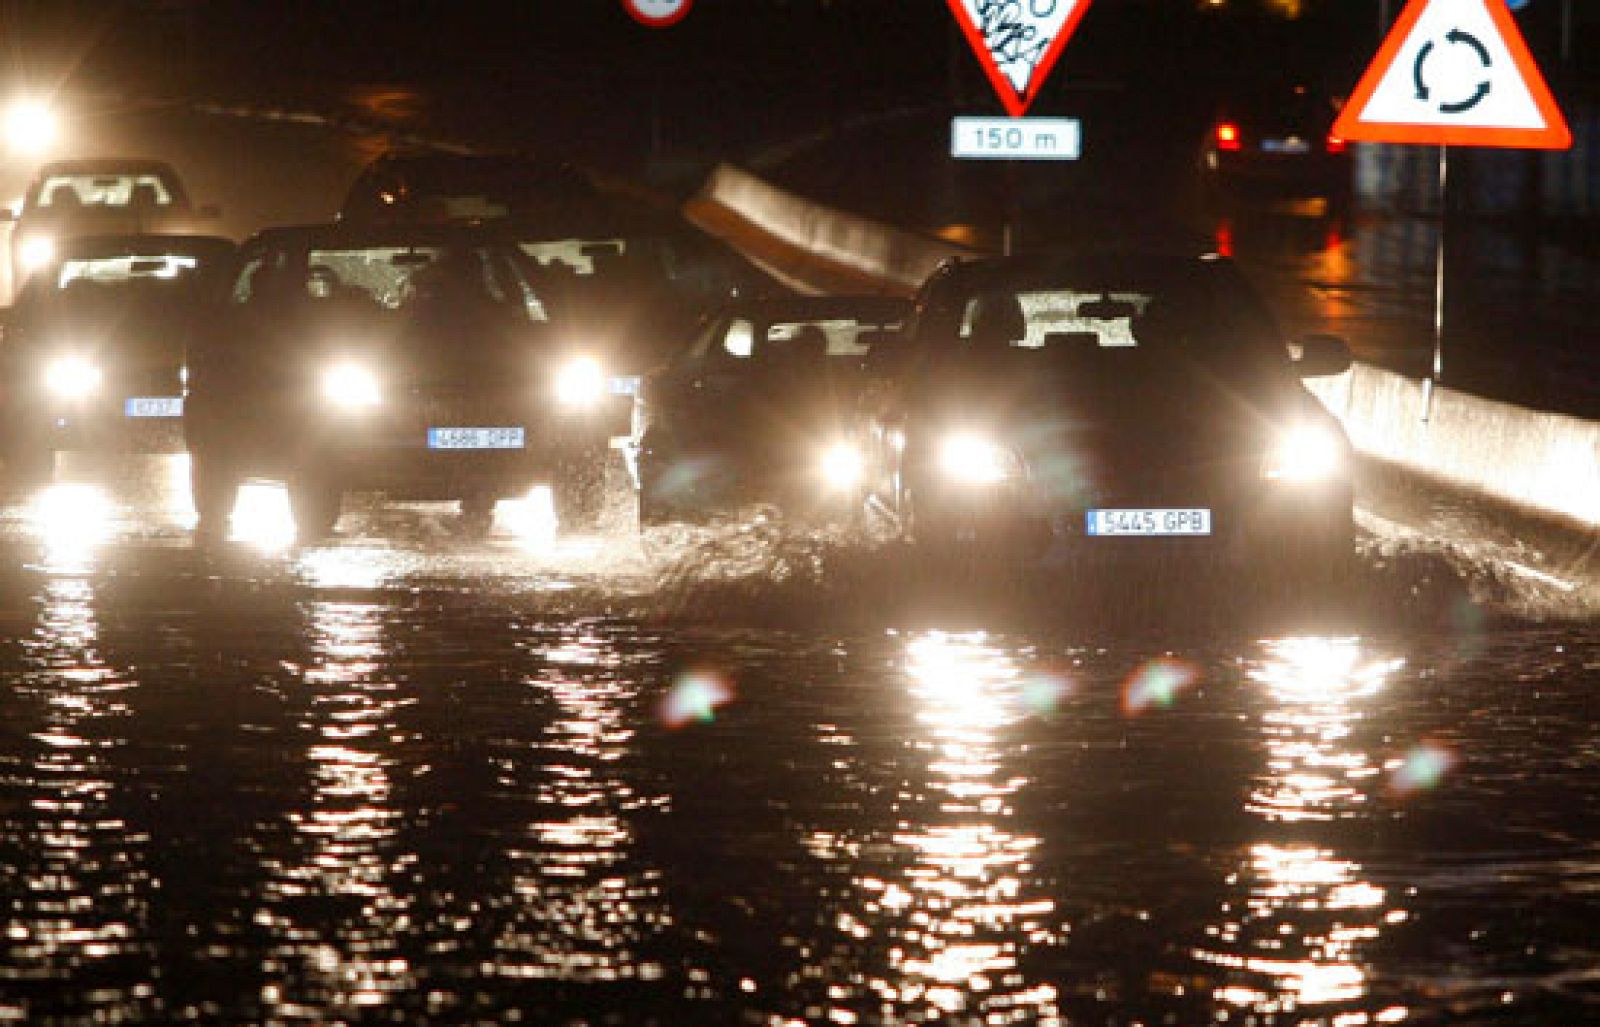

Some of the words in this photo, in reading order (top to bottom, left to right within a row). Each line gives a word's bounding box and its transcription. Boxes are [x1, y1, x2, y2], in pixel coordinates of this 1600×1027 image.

[972, 128, 1022, 149] 150
[1034, 133, 1057, 150] m
[1104, 511, 1156, 533] 5445
